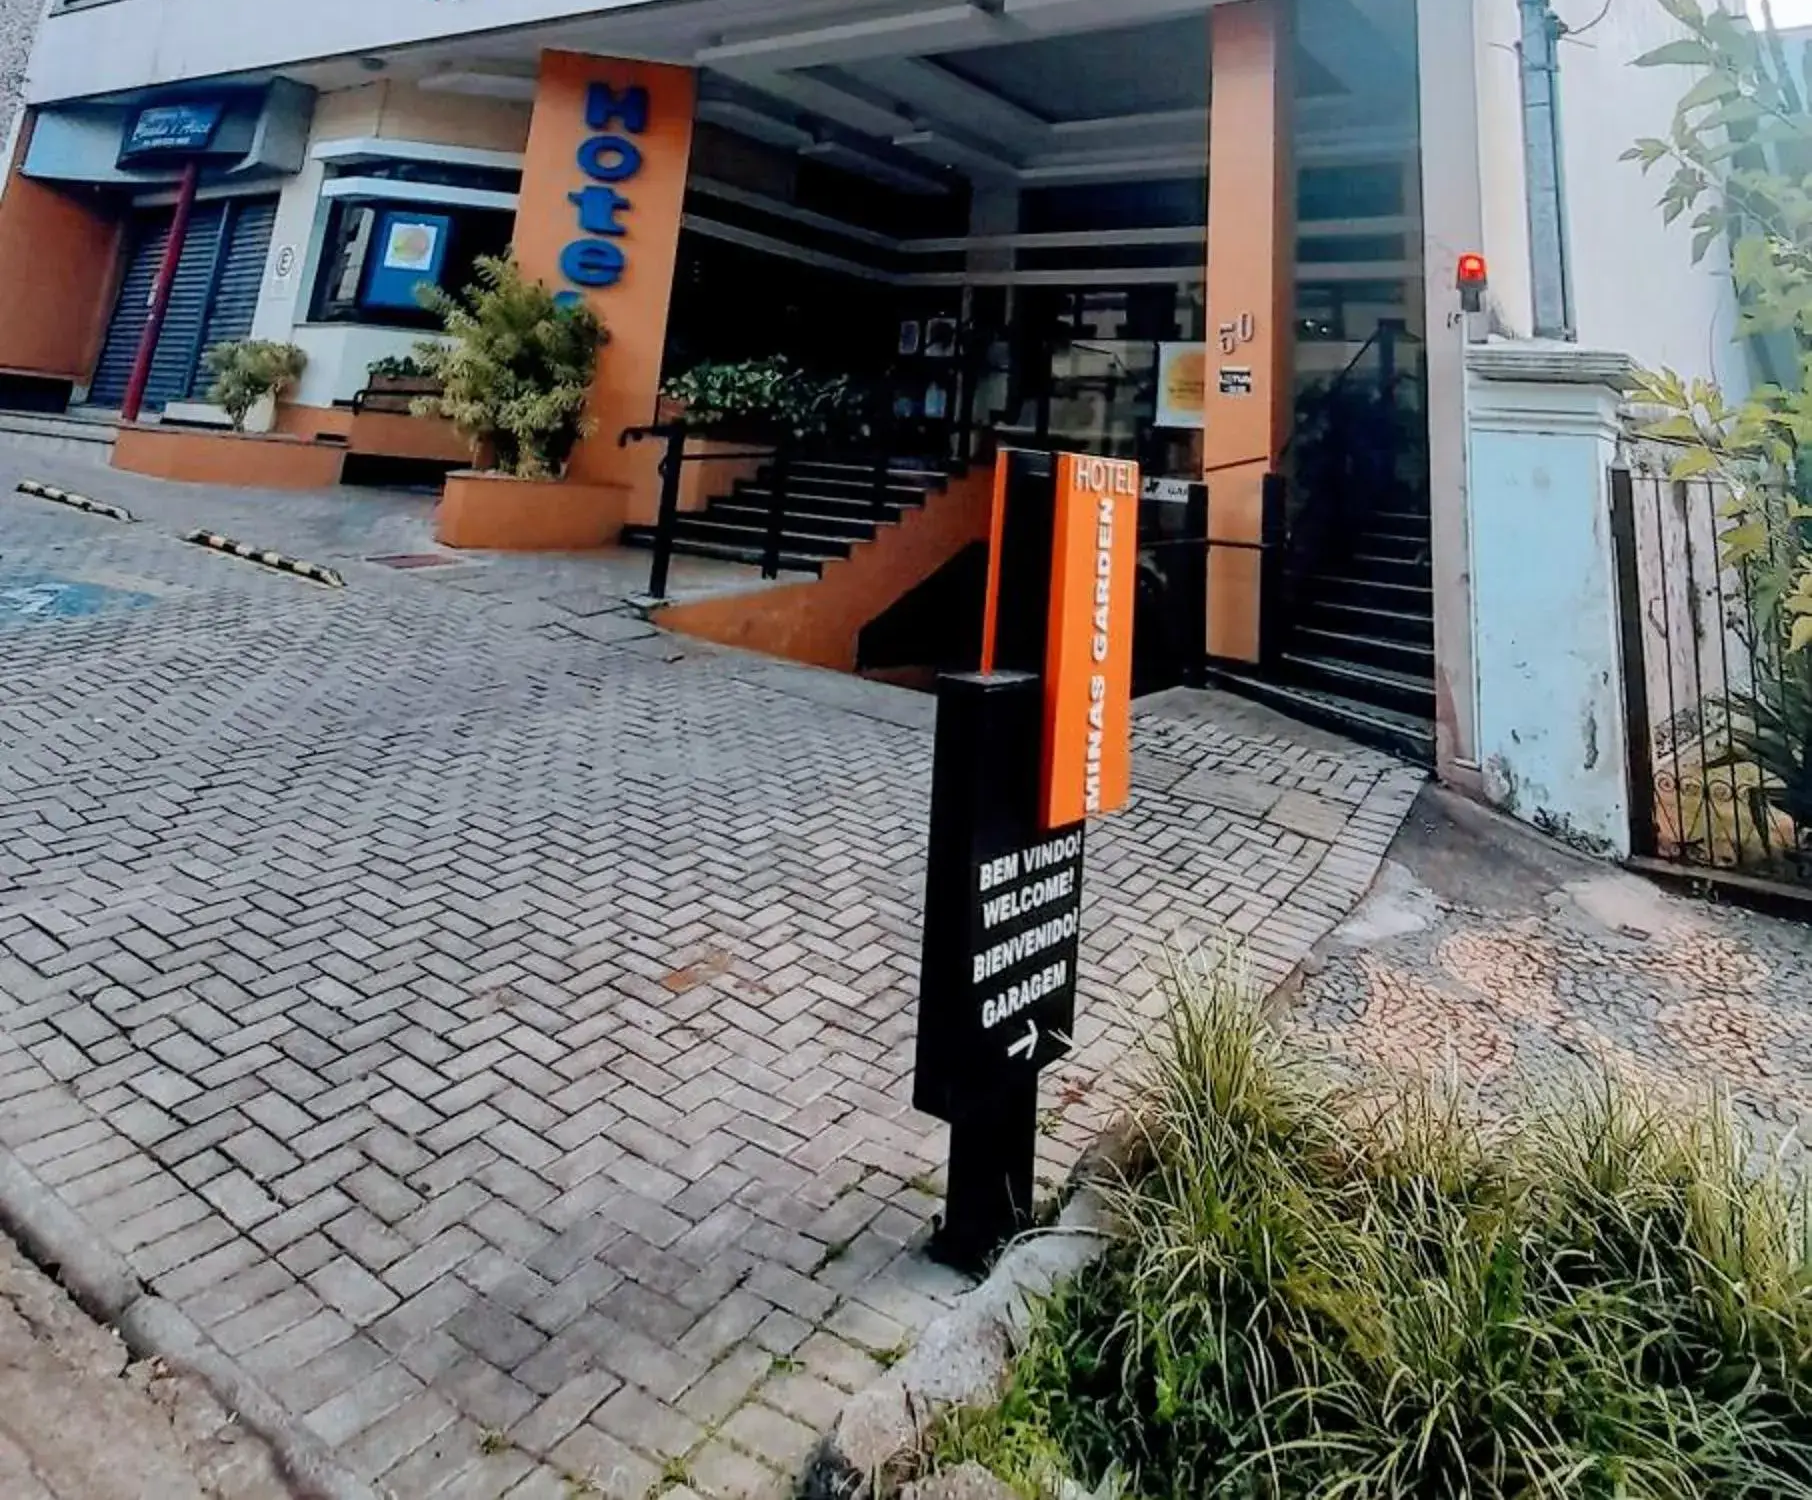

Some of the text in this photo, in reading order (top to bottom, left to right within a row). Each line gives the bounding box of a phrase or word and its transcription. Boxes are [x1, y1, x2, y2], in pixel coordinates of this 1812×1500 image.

[553, 82, 650, 309] Hote
[1219, 312, 1255, 355] 50
[1075, 456, 1137, 494] HOTEL
[1085, 497, 1114, 814] MINAS GARDEN
[979, 830, 1082, 891] BEM VINDO!
[982, 867, 1074, 930] WELCOME!
[973, 906, 1079, 984] BIENVENIDO!
[982, 959, 1067, 1028] GARAGEM
